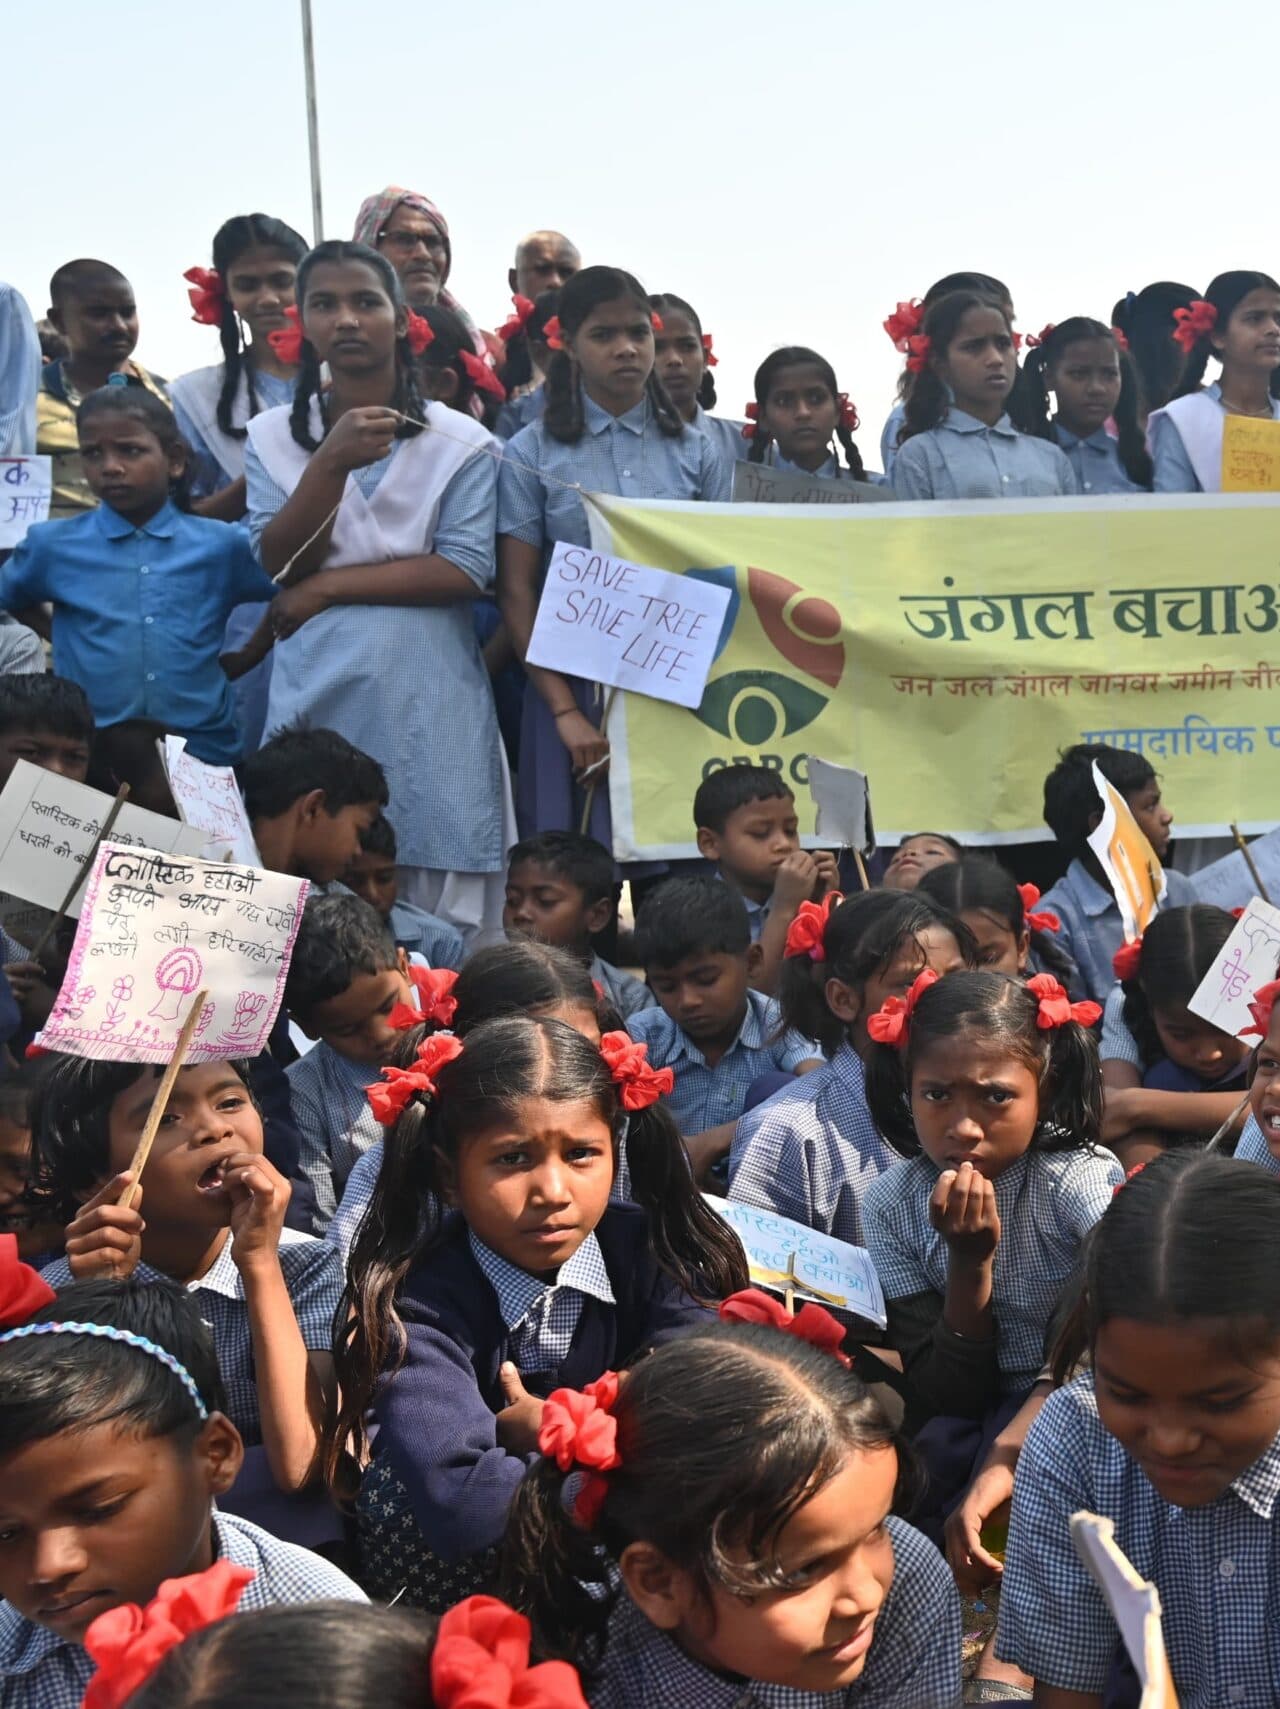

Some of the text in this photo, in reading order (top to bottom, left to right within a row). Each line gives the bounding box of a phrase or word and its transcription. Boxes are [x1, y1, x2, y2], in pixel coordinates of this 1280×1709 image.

[559, 549, 707, 640] SAVE TREE
[899, 576, 1094, 641] जंगल
[556, 590, 693, 682] SAVE LIFE
[890, 675, 937, 697] जन
[943, 675, 997, 697] जल
[1004, 670, 1073, 698] जंगल
[1079, 674, 1161, 694] जानवर
[1167, 663, 1234, 693] जमीन
[105, 850, 195, 885] प्लास्टिक
